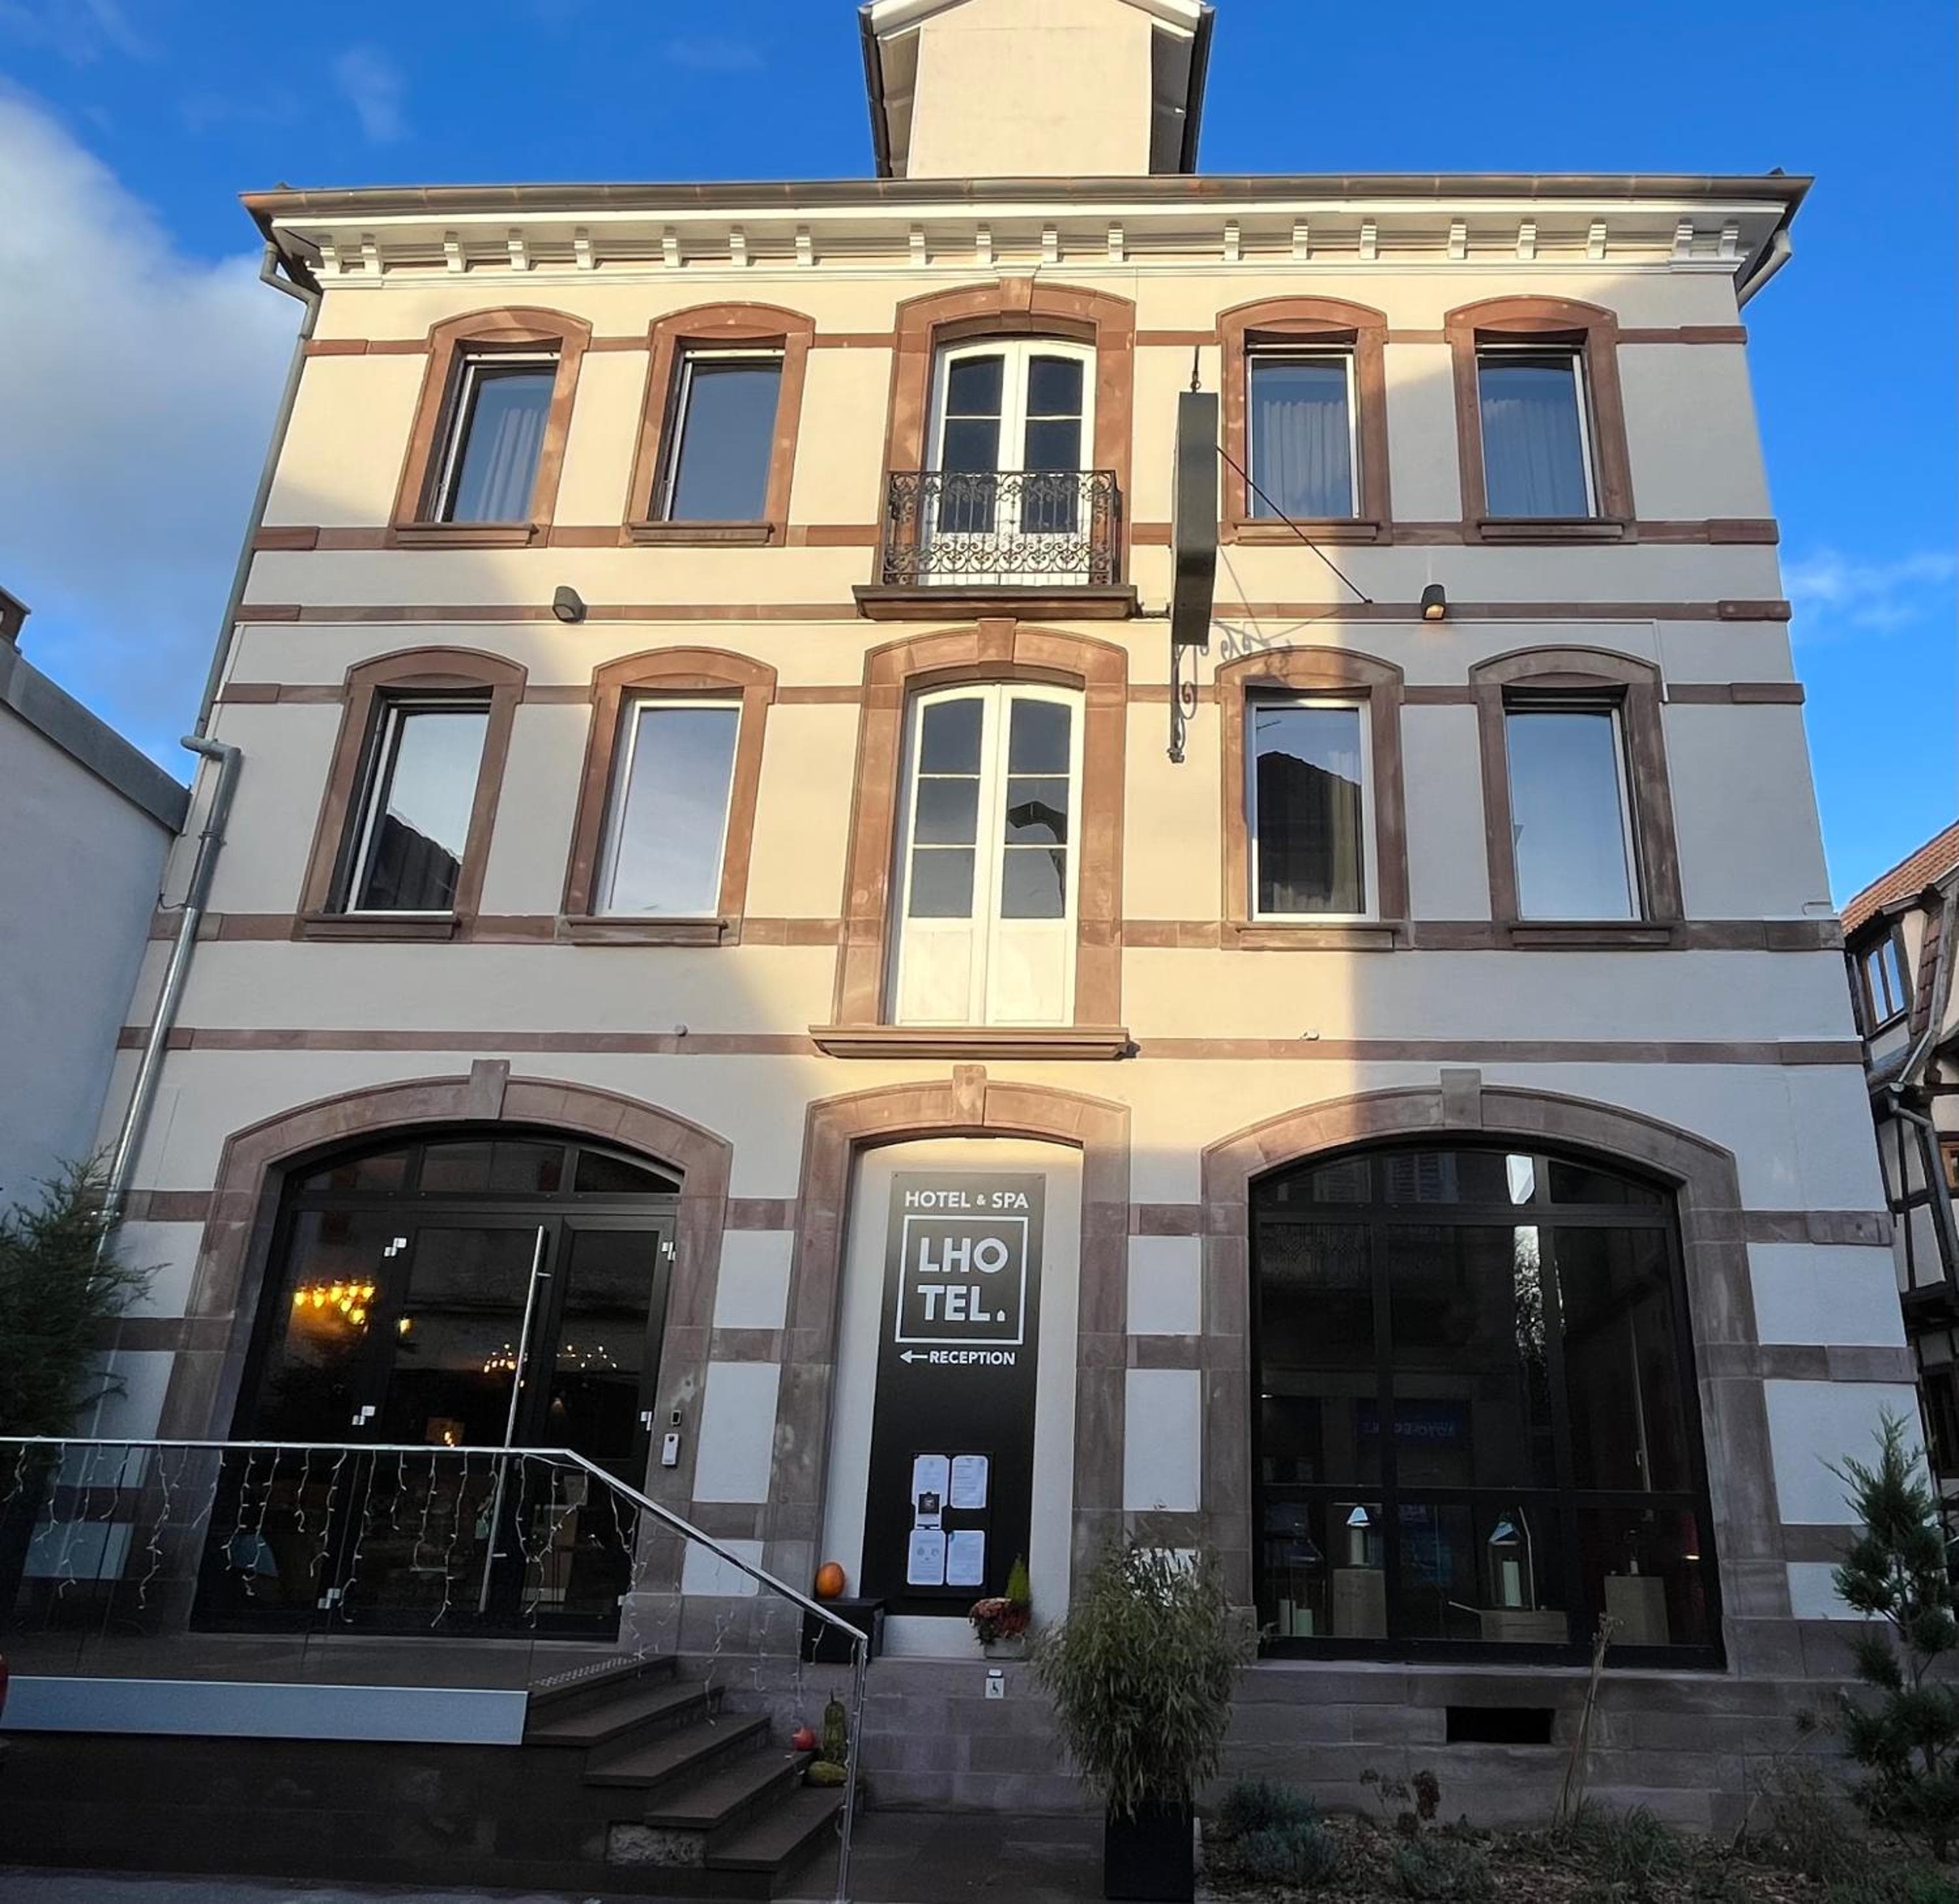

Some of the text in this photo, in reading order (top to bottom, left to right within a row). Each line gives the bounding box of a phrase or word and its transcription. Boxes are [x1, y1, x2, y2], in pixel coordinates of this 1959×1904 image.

[905, 1191, 1029, 1208] HOTEL & SPA
[919, 1237, 1009, 1273] LHO
[929, 1351, 1015, 1365] RECEPTION
